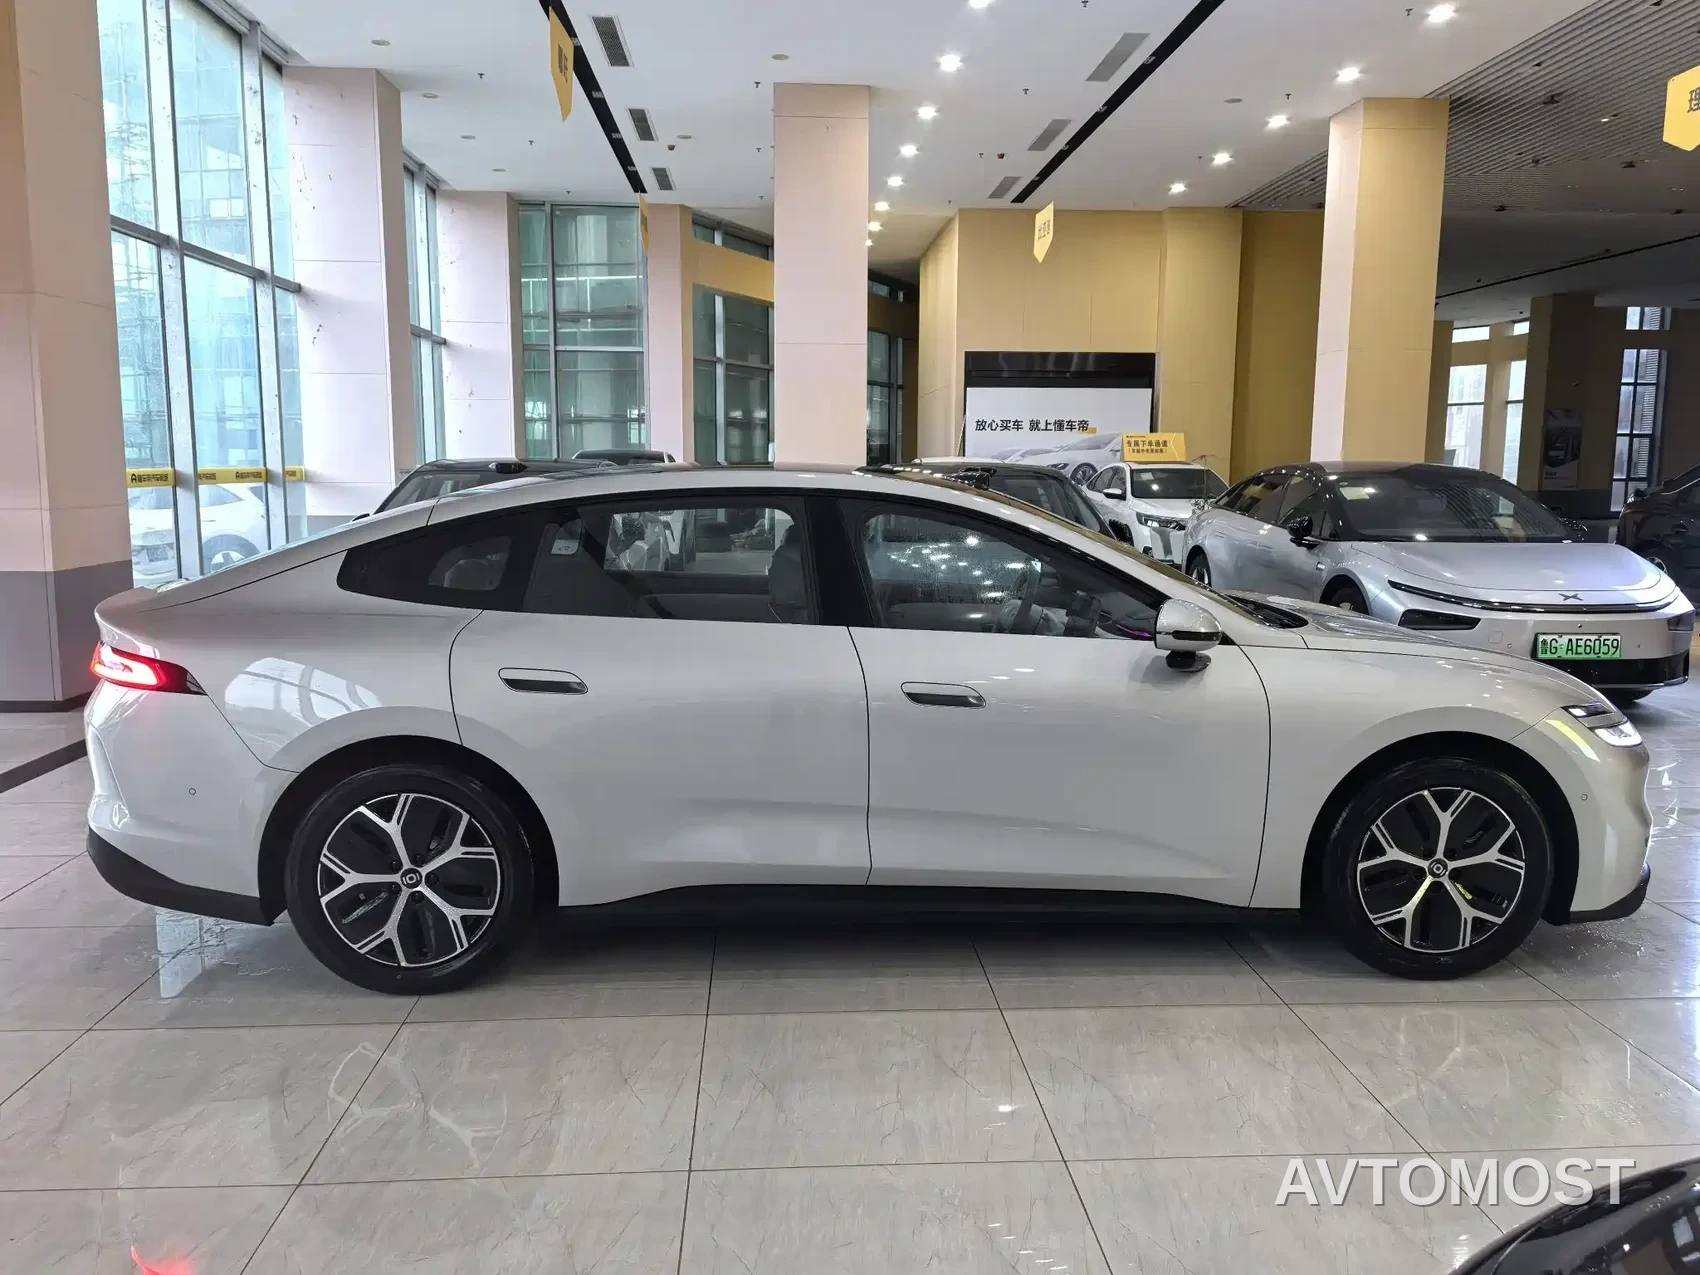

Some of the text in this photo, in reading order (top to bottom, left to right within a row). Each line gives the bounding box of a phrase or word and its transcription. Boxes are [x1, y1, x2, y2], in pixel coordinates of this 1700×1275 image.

[975, 419, 1090, 432] 放心买车 就上懂车帝
[1566, 638, 1620, 656] AE6059
